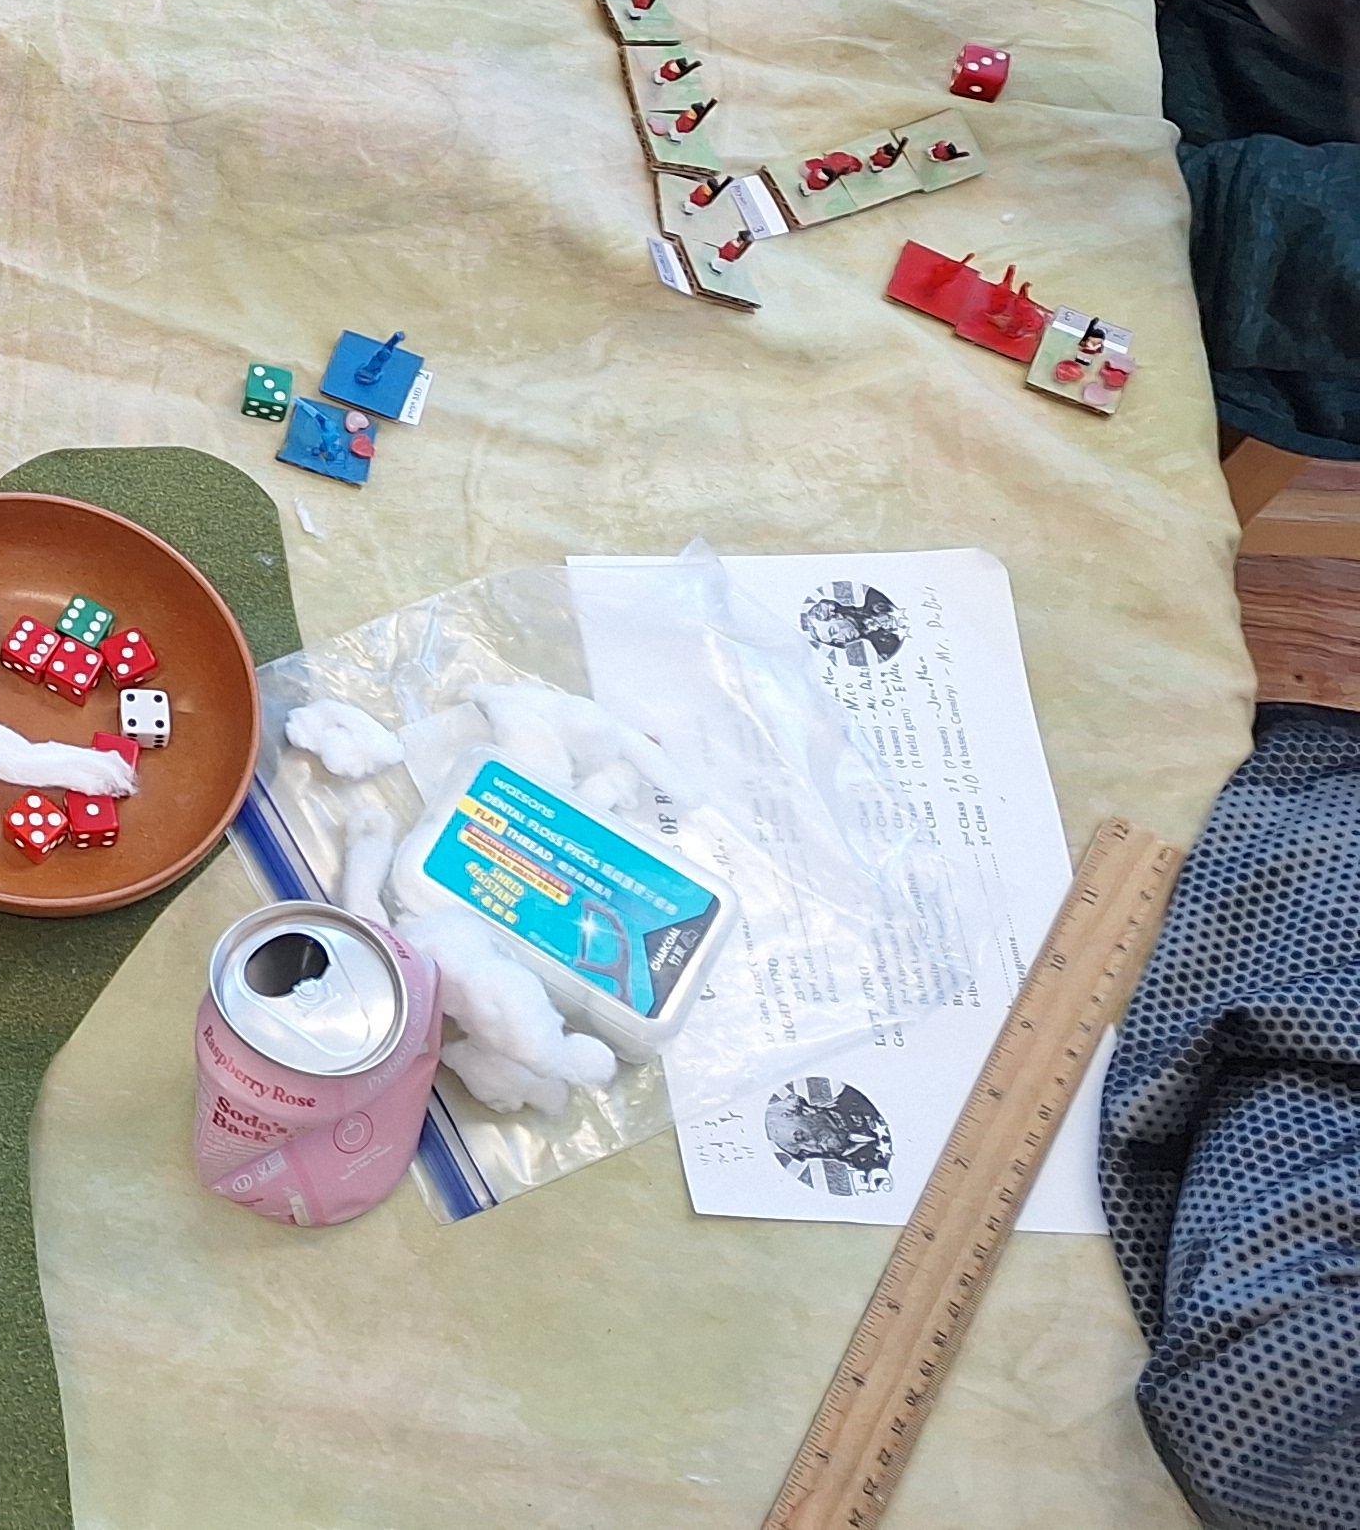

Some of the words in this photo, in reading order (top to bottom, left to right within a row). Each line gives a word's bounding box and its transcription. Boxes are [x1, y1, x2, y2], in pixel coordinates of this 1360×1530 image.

[492, 777, 556, 820] watsons
[924, 800, 936, 829] Class
[958, 802, 969, 830] Class
[473, 807, 503, 831] FLAT
[505, 827, 554, 863] THREAD
[480, 791, 526, 824] DENTAL
[527, 818, 565, 847] FLOSS
[564, 839, 601, 869] PICKS
[659, 813, 679, 835] OF
[976, 805, 987, 832] Class
[465, 862, 518, 908] RESISTANT
[490, 866, 524, 895] SHRED
[649, 927, 682, 972] CHARCOAL
[202, 1024, 270, 1098] Raspberry
[271, 1084, 316, 1108] Rose
[212, 1110, 268, 1143] Back
[215, 1095, 288, 1134] Soda's
